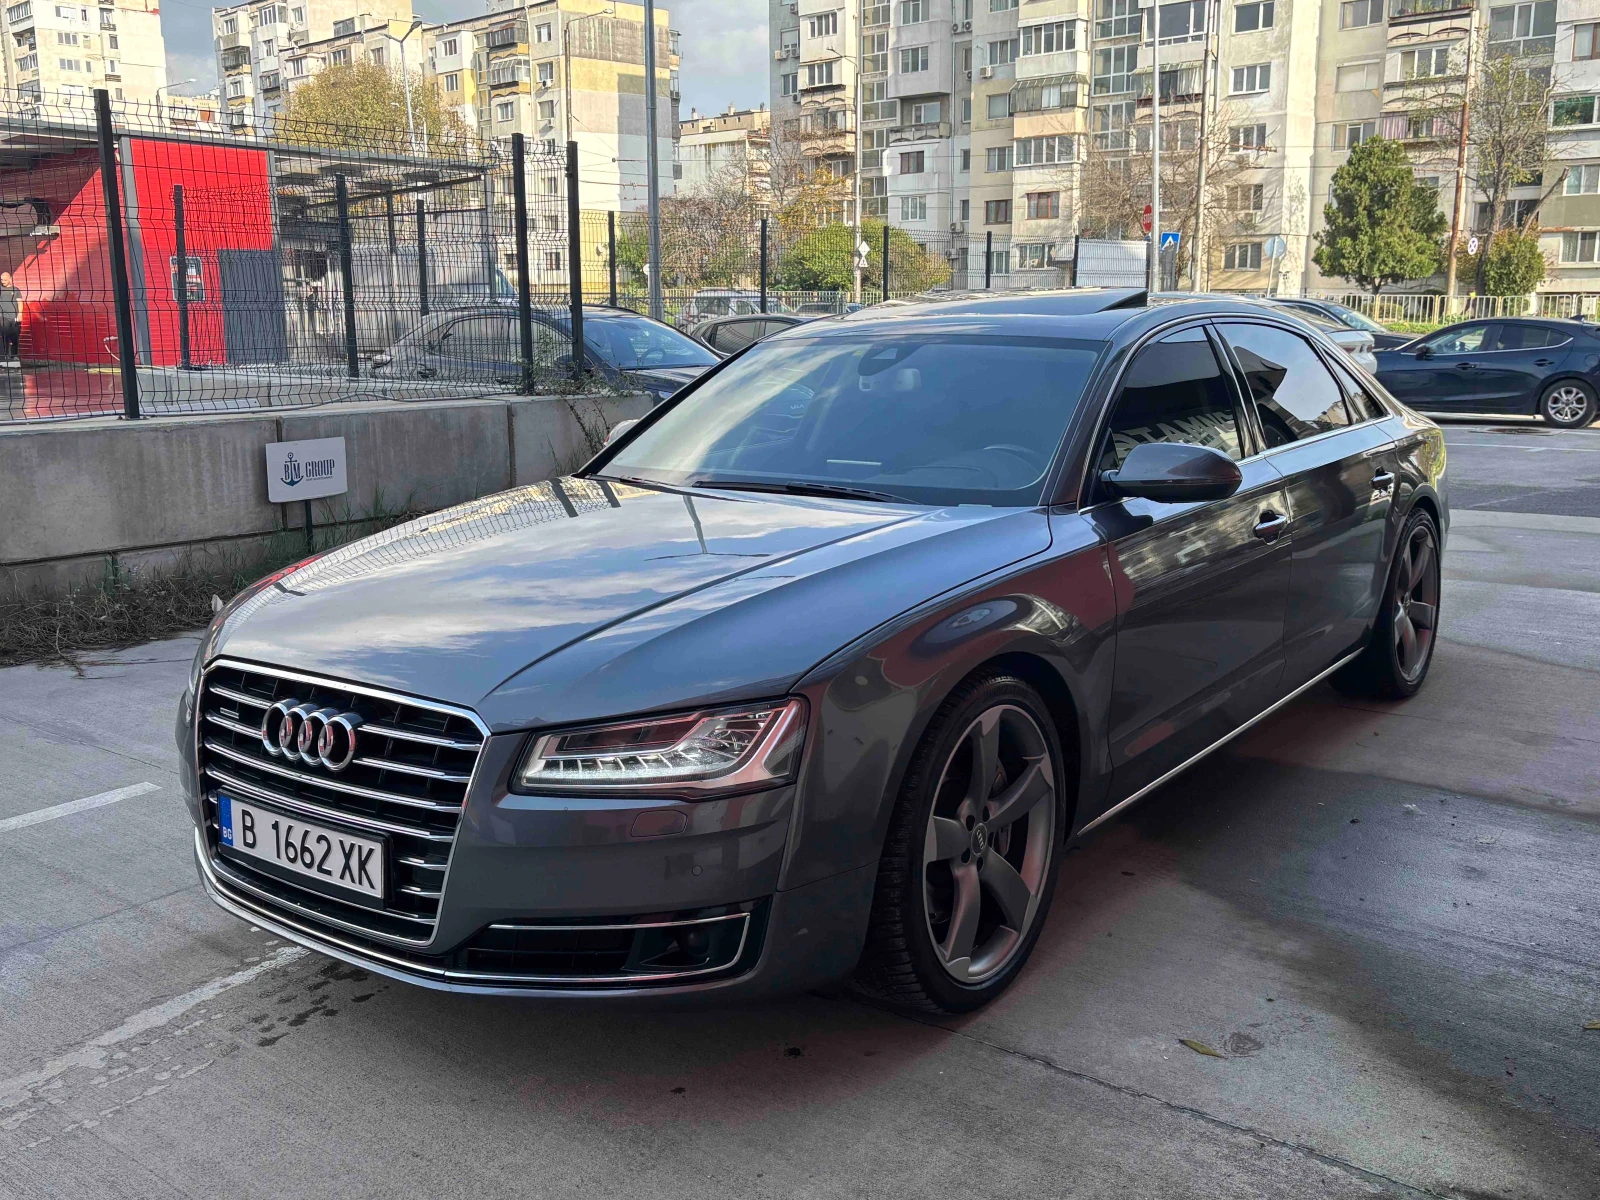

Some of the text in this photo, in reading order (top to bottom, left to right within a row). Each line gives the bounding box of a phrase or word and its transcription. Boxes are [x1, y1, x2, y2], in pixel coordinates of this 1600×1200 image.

[305, 458, 335, 478] GROUP
[222, 826, 233, 840] BG
[241, 808, 376, 890] B 1662 XK
